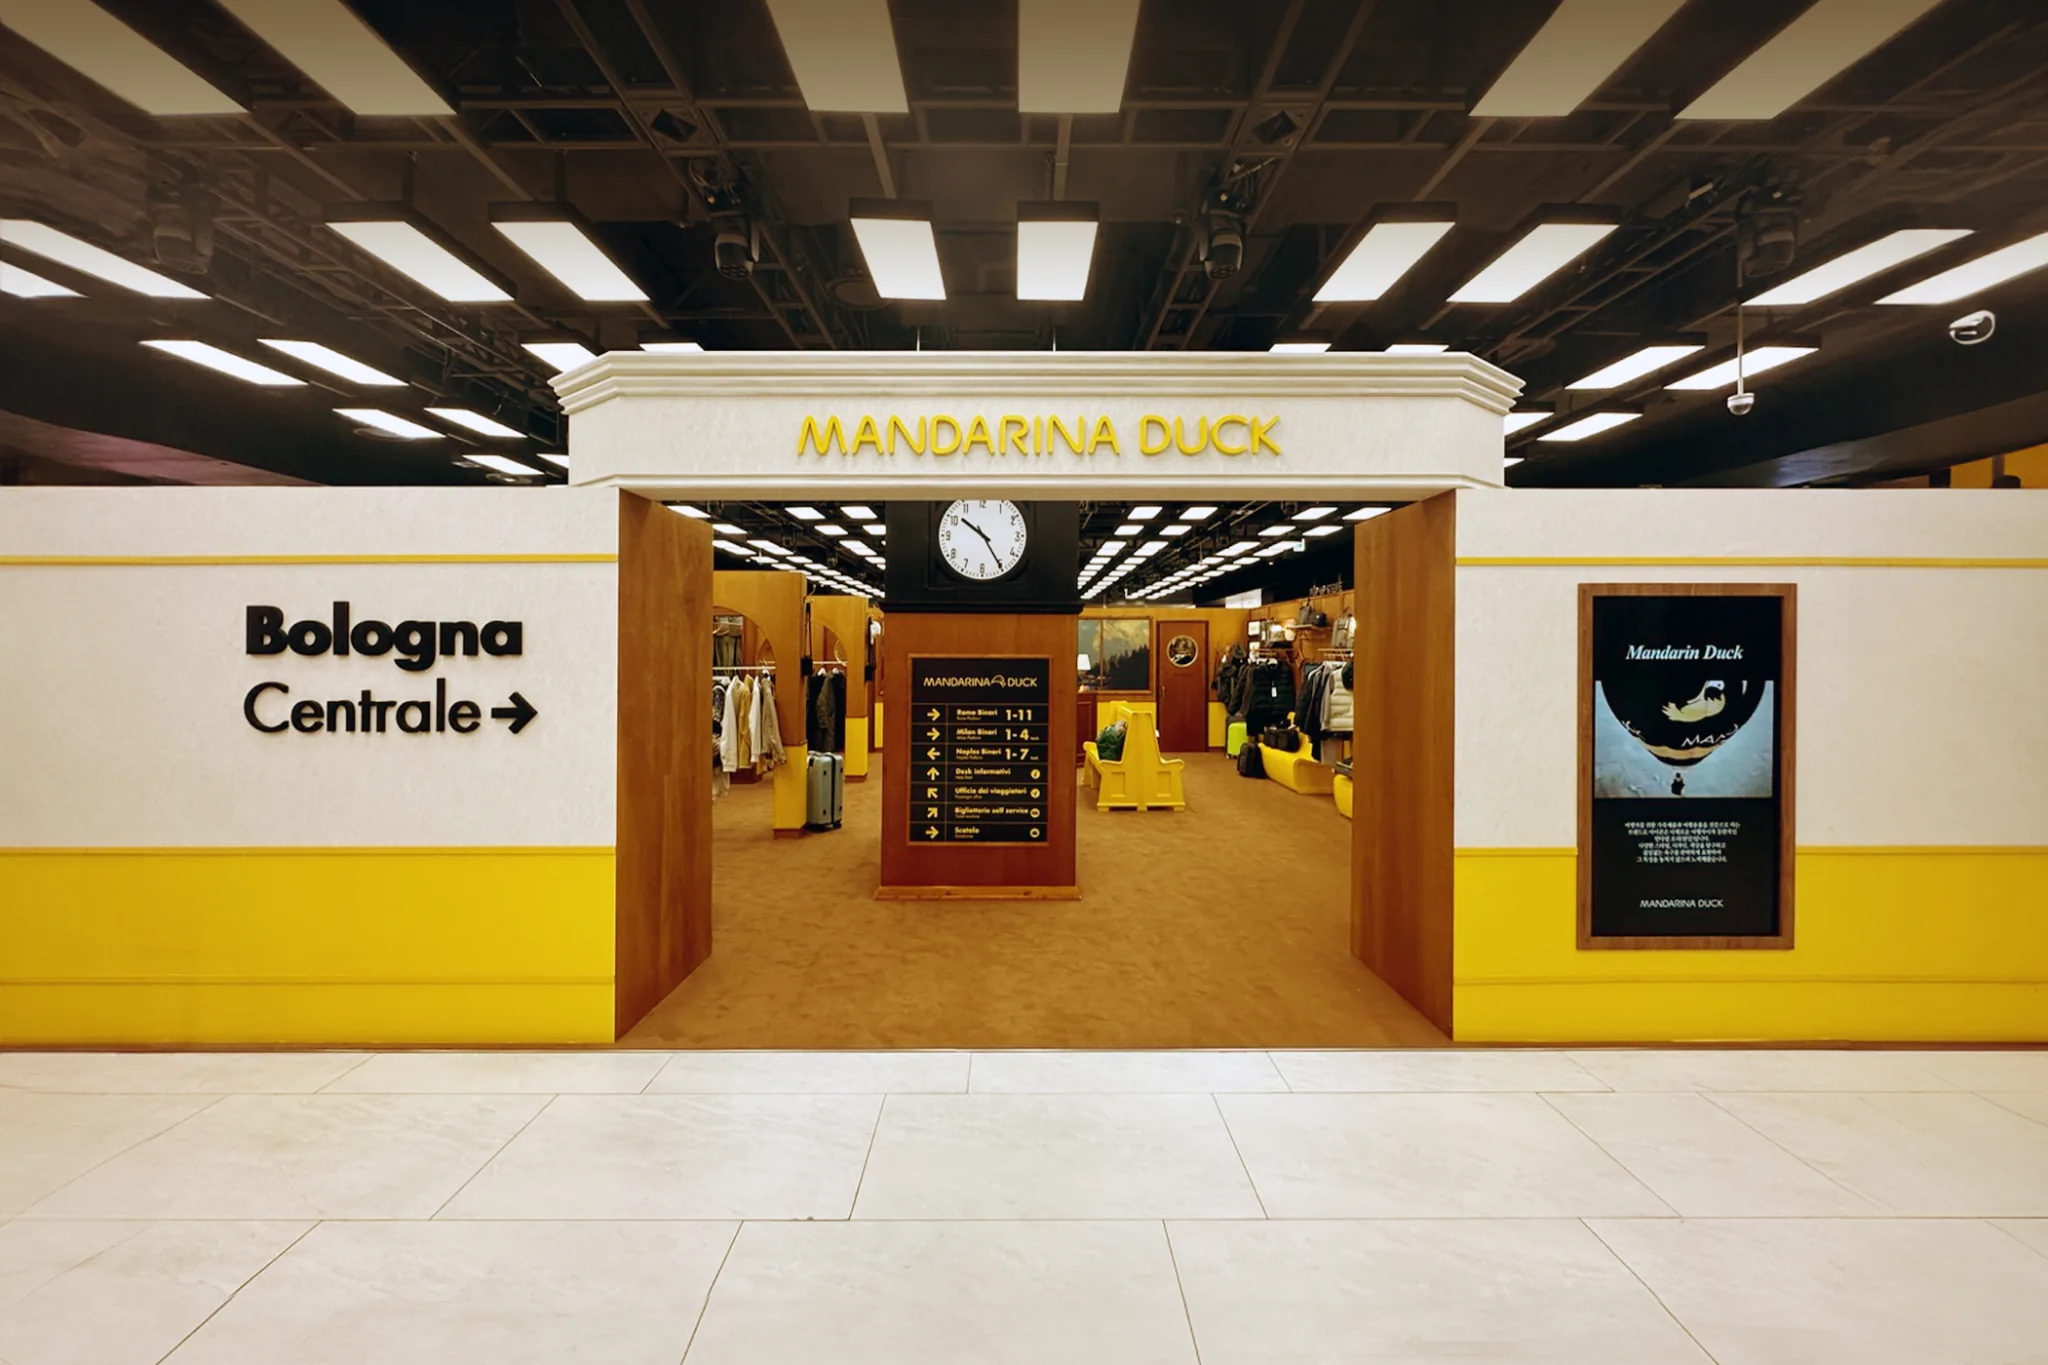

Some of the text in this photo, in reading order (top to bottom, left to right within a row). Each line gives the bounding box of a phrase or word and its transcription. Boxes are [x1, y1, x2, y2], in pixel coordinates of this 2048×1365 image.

[798, 414, 1281, 457] MANDARINA DUCK
[963, 503, 969, 514] 11
[950, 515, 959, 526] 10
[1010, 515, 1016, 526] 2
[945, 530, 951, 541] 9
[1014, 531, 1020, 542] 3
[950, 548, 957, 559] 8
[1010, 547, 1016, 557] 4
[963, 558, 969, 569] 7
[980, 563, 985, 574] 6
[246, 602, 523, 672] Bologna
[1625, 644, 1744, 660] Mandarin Duck
[923, 677, 1037, 687] MANDARINA DUCK
[244, 678, 481, 734] Centrale
[1005, 709, 1032, 721] 1-11
[1640, 899, 1724, 908] MANDARINA DUCK
